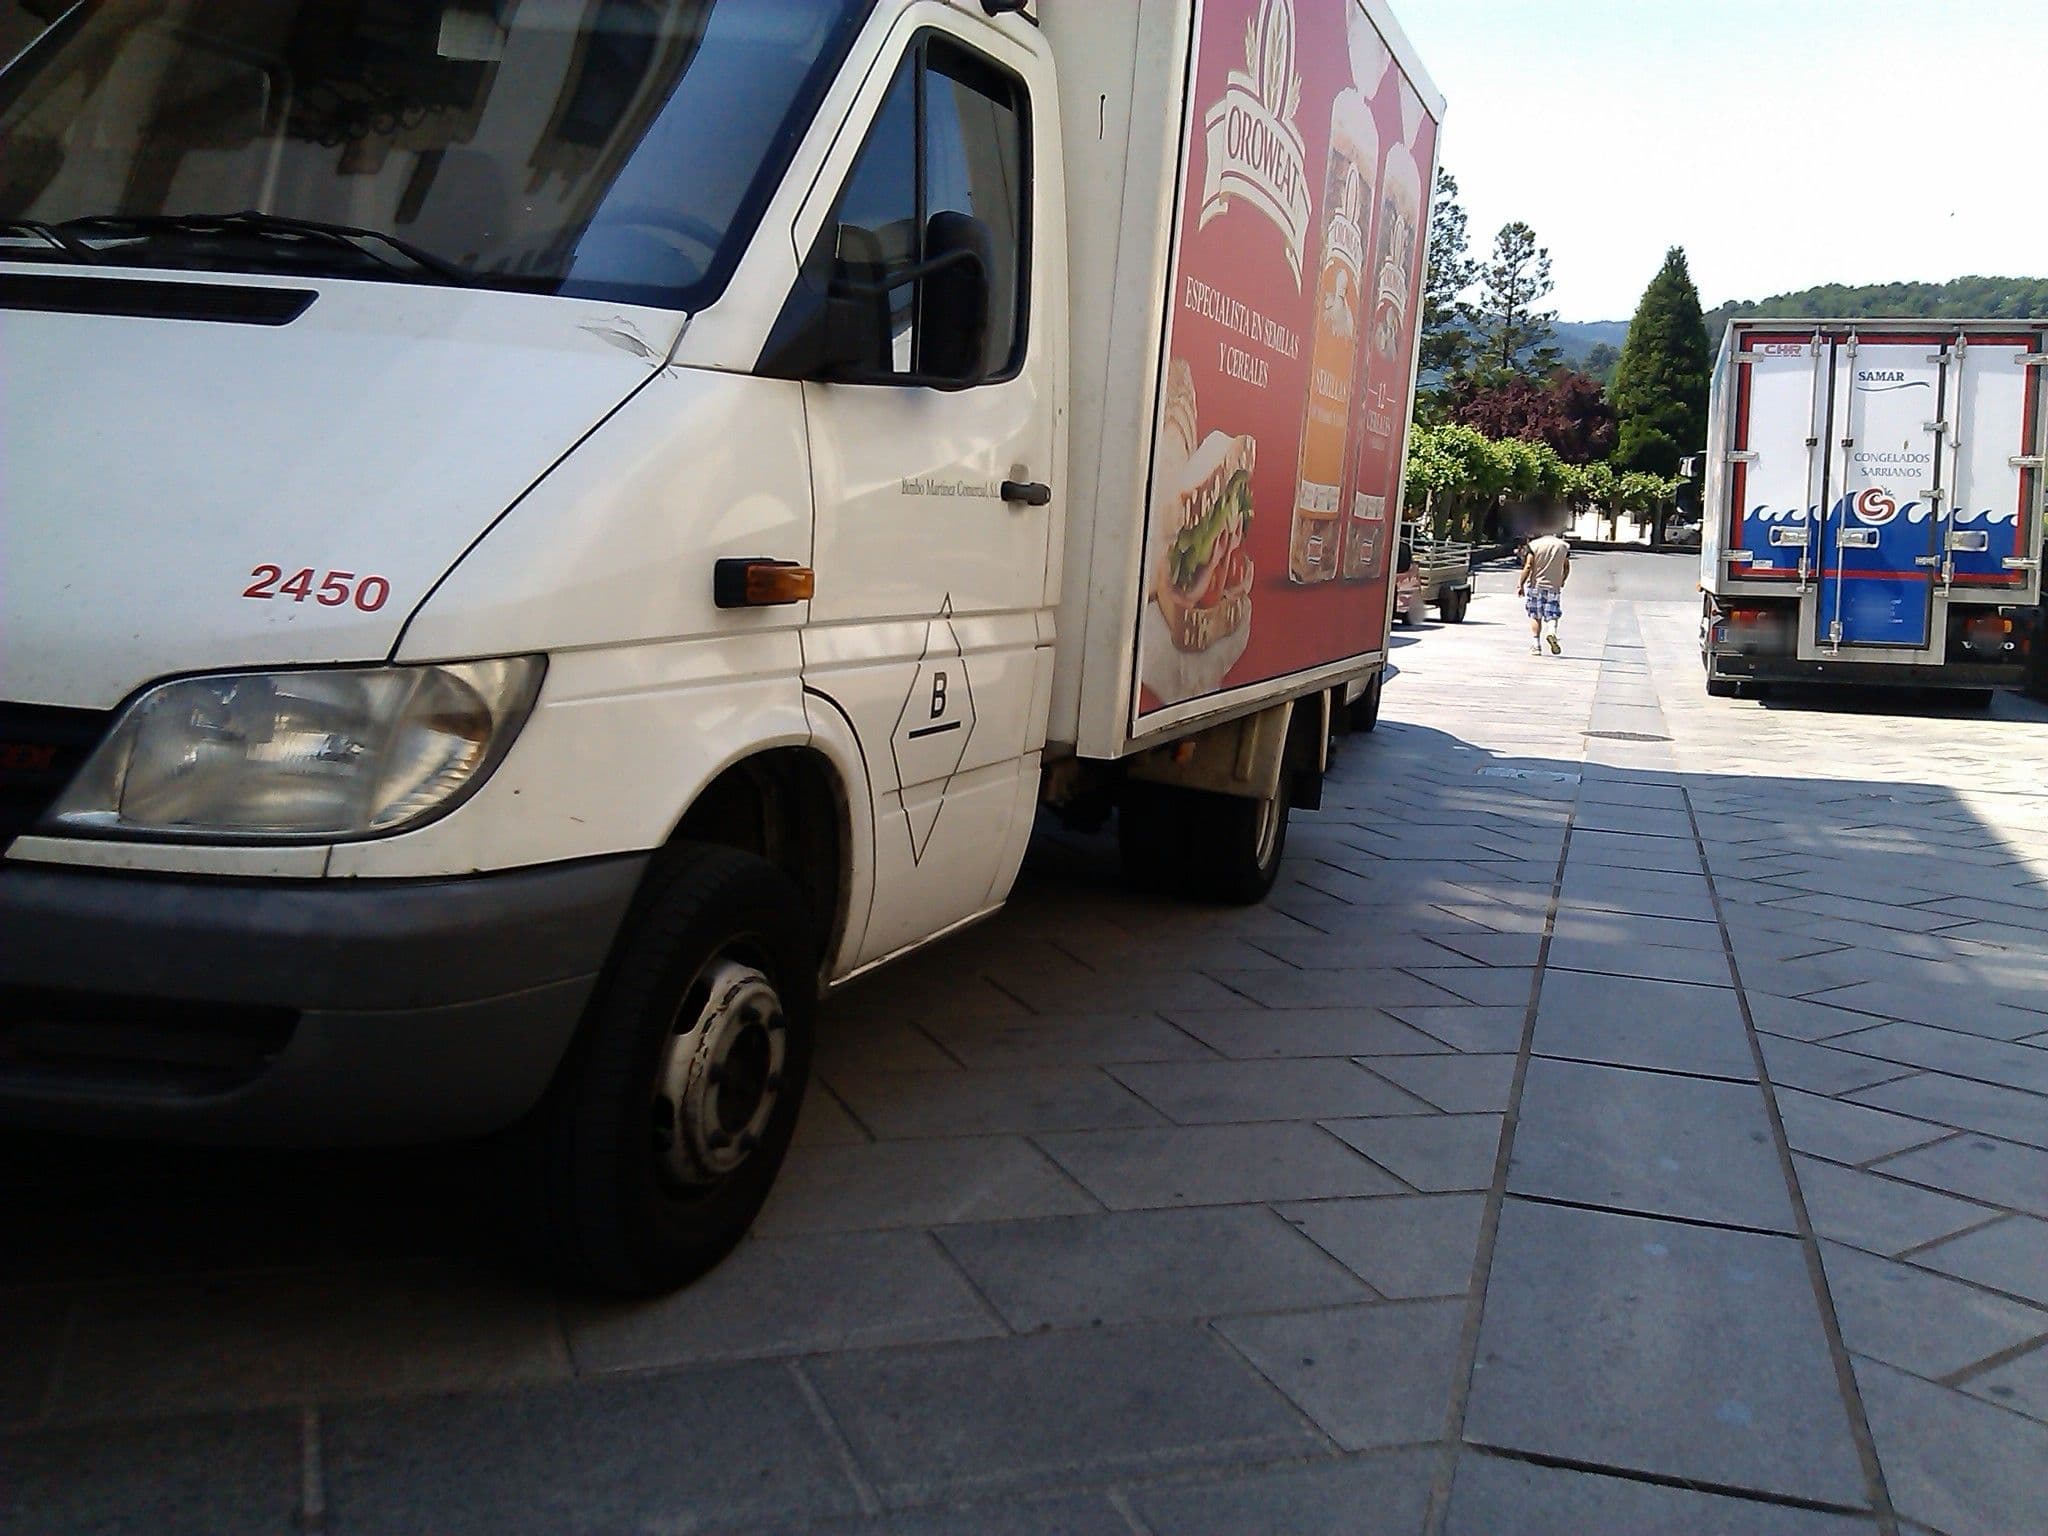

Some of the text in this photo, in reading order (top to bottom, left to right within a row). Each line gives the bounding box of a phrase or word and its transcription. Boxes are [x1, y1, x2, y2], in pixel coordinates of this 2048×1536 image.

[1228, 106, 1300, 208] OROWEAT
[1185, 276, 1300, 360] ESPECIALISTA EN SEMILLAS
[1219, 342, 1269, 388] Y CEREALES
[1858, 371, 1905, 382] SAMAR
[1854, 453, 1930, 463] CONGELADOS
[1861, 467, 1922, 477] SARRIANOS
[242, 564, 391, 613] 2450
[930, 672, 948, 719] B
